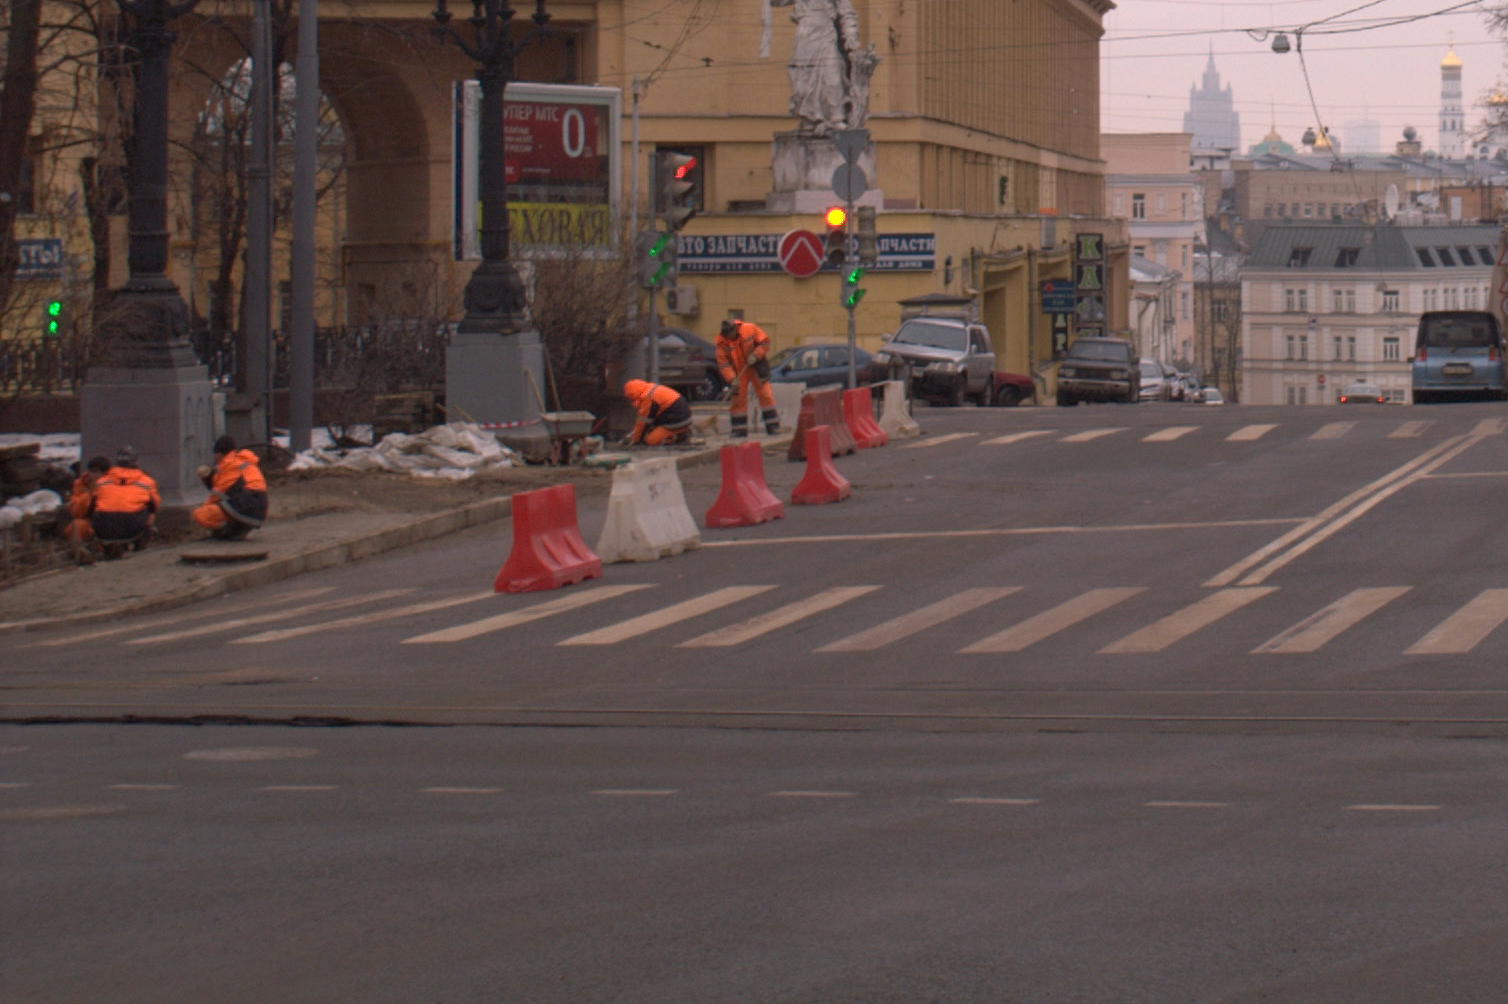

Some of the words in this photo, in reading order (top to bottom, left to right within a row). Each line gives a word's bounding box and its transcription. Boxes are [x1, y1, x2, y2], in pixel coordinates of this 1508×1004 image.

[503, 105, 532, 120] УПЕР
[536, 106, 560, 122] МТС
[562, 108, 586, 158] 0
[508, 208, 606, 246] ЕХОВАЯ
[677, 237, 705, 254] ВТО
[877, 238, 935, 252] ПЧАСТИ
